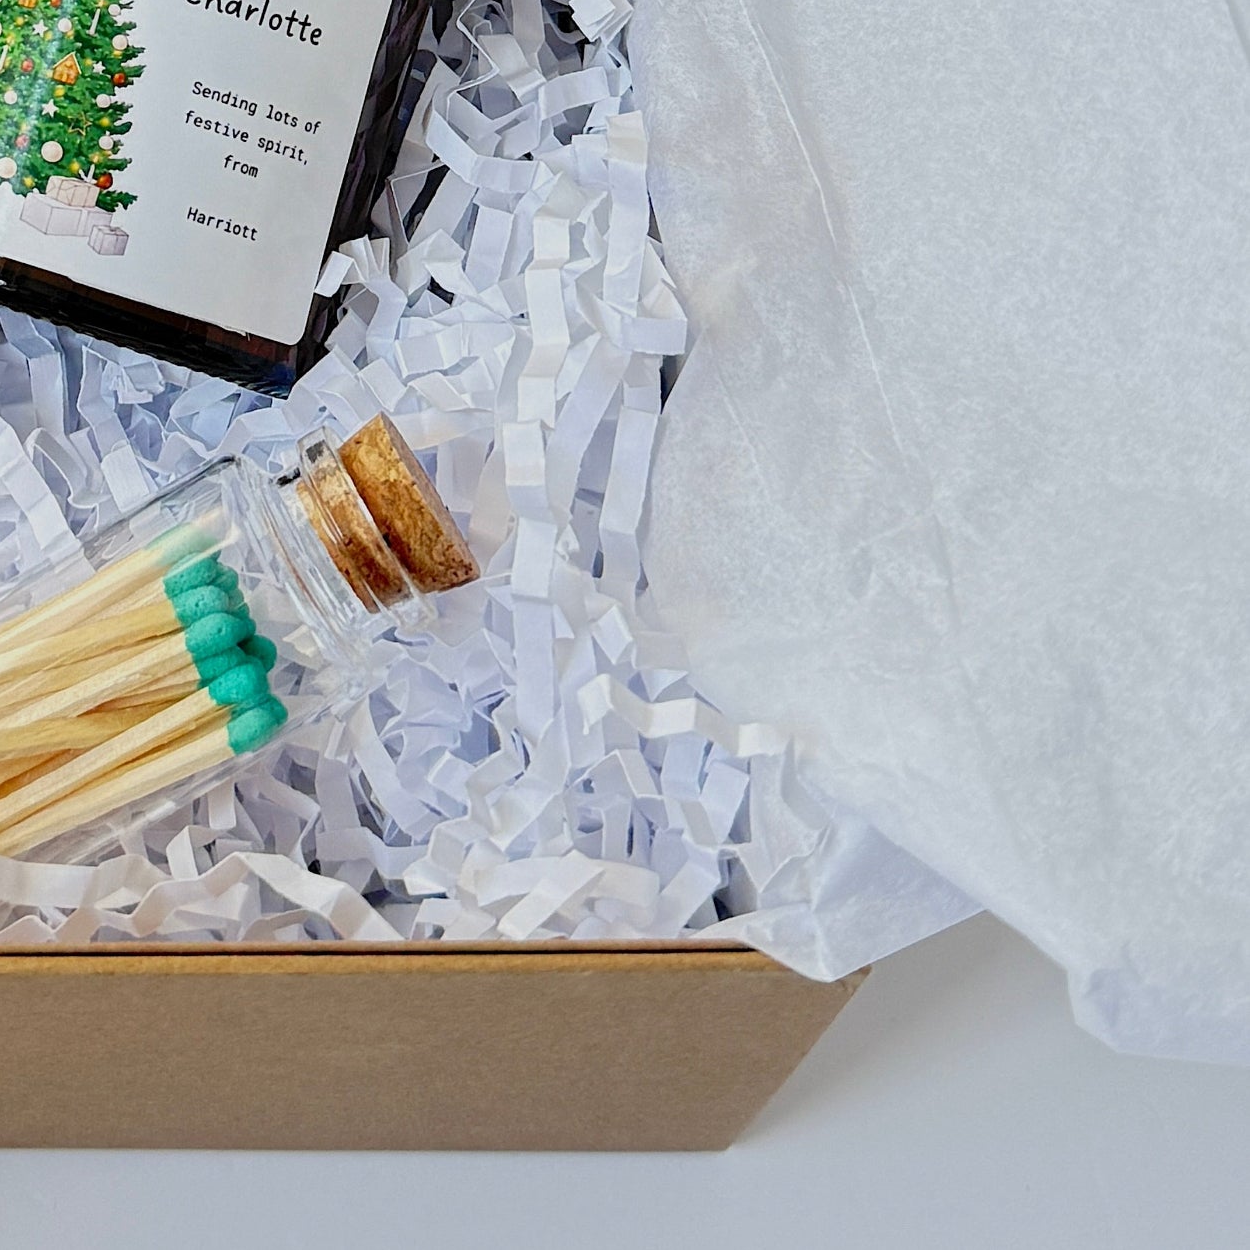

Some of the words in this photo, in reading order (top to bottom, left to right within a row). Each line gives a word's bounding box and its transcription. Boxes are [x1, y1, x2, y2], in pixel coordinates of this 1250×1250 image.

[192, 81, 258, 116] Sending
[266, 104, 299, 127] lots
[304, 120, 321, 135] of
[184, 110, 249, 142] festive
[257, 135, 309, 166] spirit,
[223, 155, 259, 178] from
[187, 207, 259, 242] Harriott
